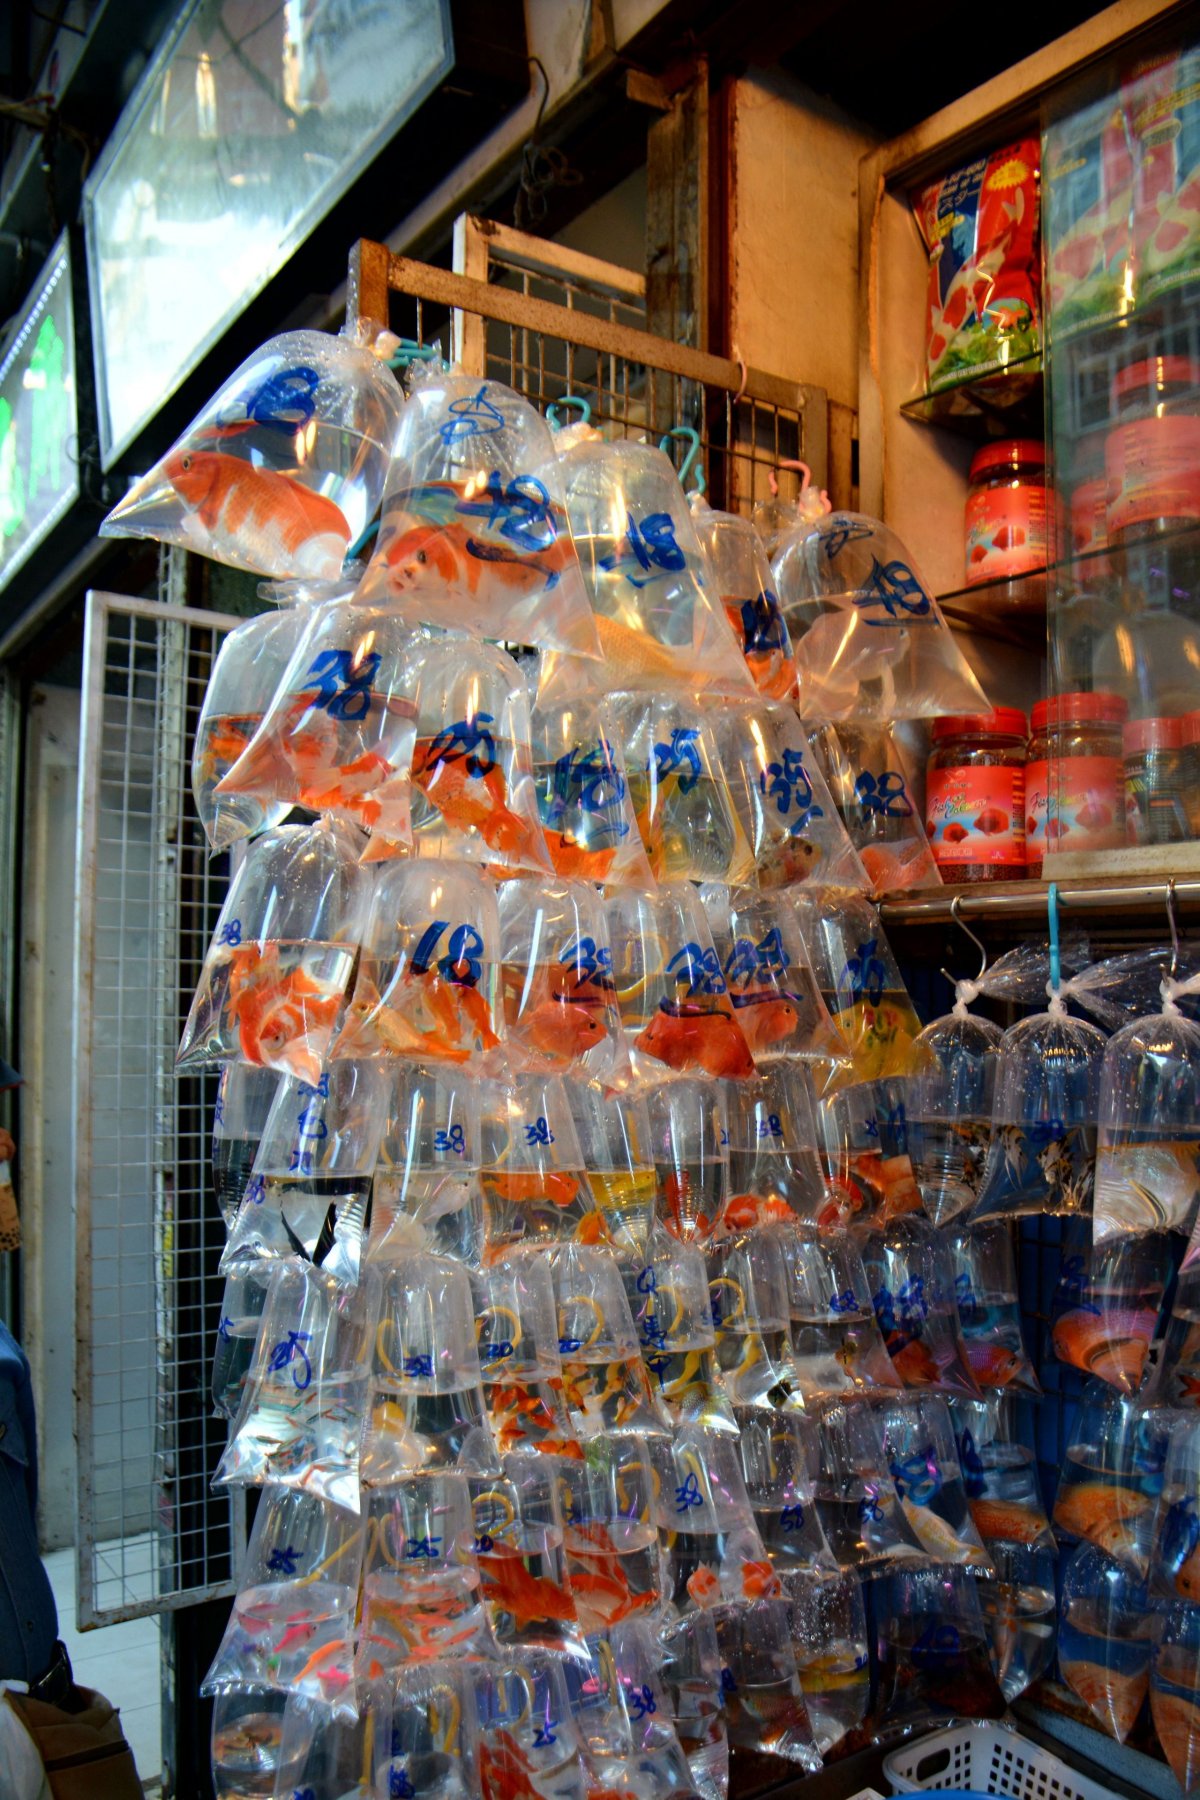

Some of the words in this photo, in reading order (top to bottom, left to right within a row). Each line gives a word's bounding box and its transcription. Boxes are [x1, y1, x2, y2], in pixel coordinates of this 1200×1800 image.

[302, 648, 381, 721] 38
[759, 748, 813, 814] 35
[854, 770, 912, 824] 38
[216, 917, 241, 947] 38
[410, 920, 484, 988] 18
[665, 942, 727, 998] 38
[434, 1125, 466, 1154] 38
[523, 1117, 555, 1146] 38
[755, 1115, 783, 1138] 38
[267, 1330, 313, 1390] 25
[486, 1341, 514, 1358] 20
[675, 1472, 703, 1512] 38
[629, 1684, 656, 1721] 38
